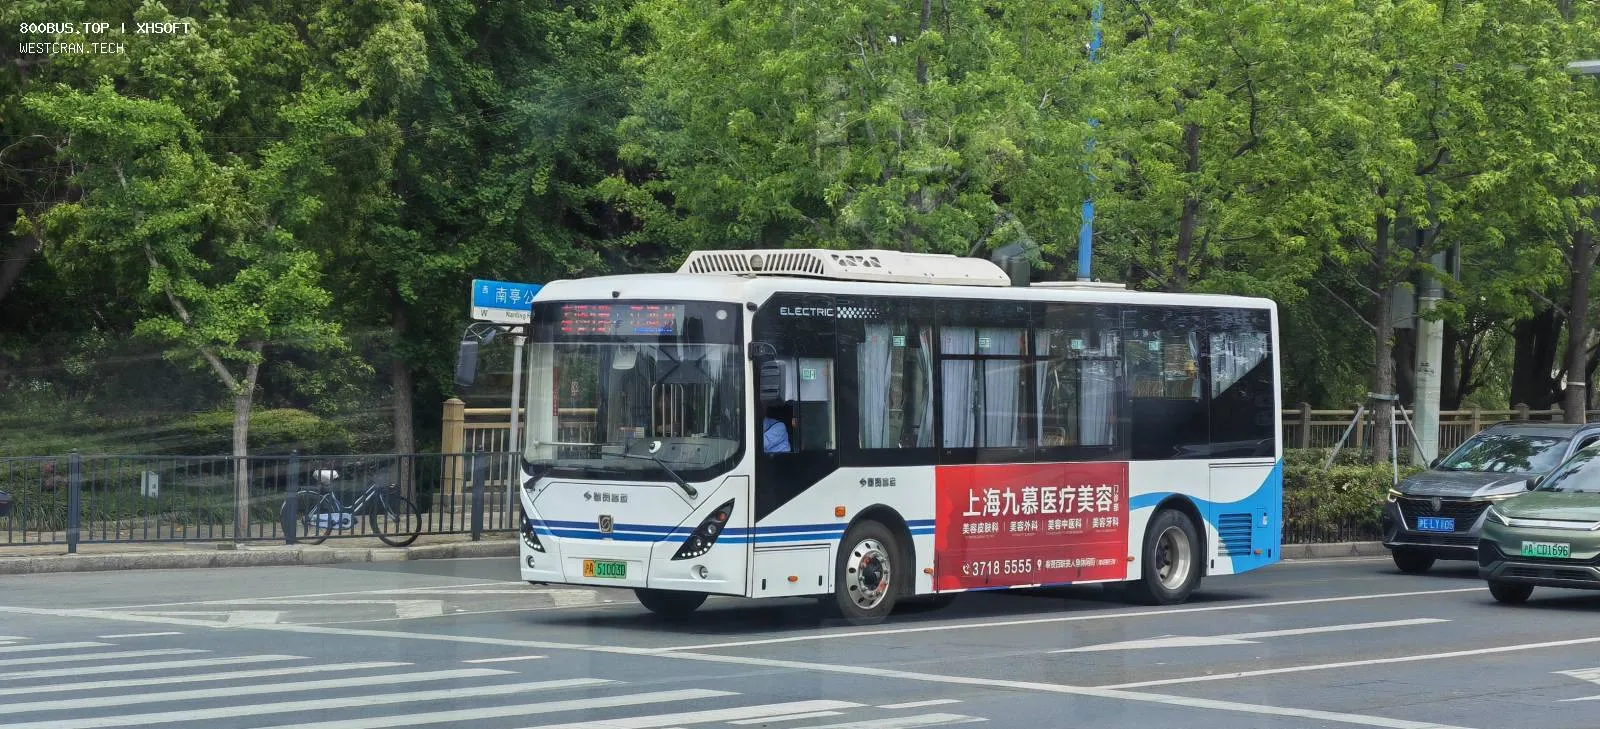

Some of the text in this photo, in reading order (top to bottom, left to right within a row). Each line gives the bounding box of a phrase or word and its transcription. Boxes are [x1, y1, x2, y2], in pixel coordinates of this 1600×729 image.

[480, 308, 488, 317] W
[780, 306, 835, 317] ELECTRIC
[962, 484, 1113, 517] 上海九慕医疗美容
[962, 515, 1119, 535] 美容皮肤科 美容外科 美容中医科 美容牙科
[972, 558, 1032, 577] 3718 5555
